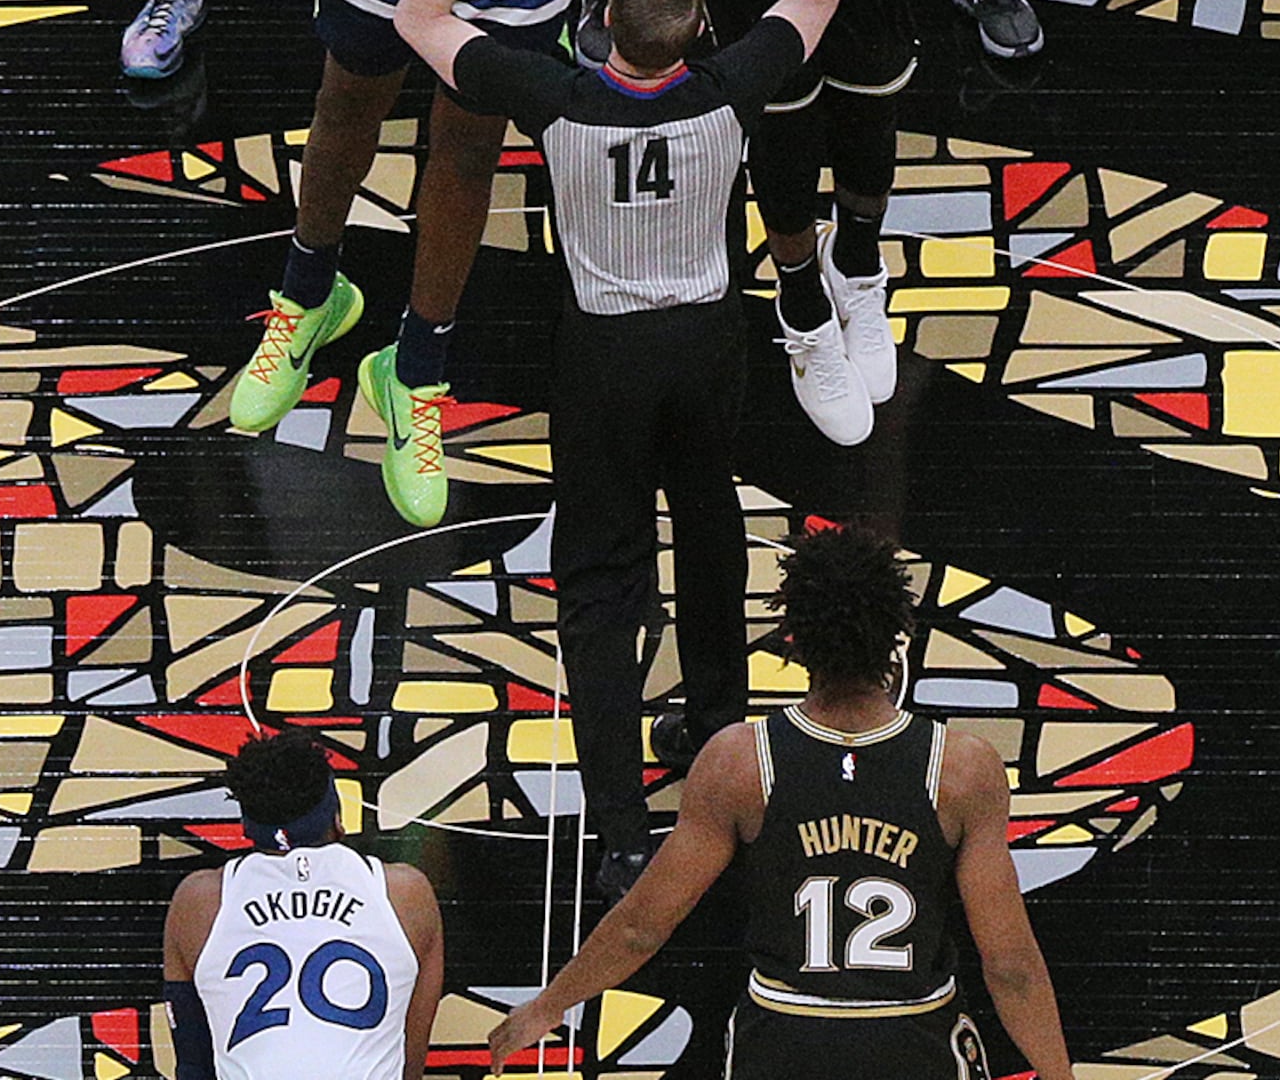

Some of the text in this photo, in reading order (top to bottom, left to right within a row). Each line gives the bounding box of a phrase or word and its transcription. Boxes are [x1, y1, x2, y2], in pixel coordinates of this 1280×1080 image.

[608, 136, 675, 204] 14
[797, 814, 919, 869] HUNTER
[243, 889, 364, 927] OKOGIE
[794, 875, 917, 972] 12
[224, 938, 389, 1053] 20
